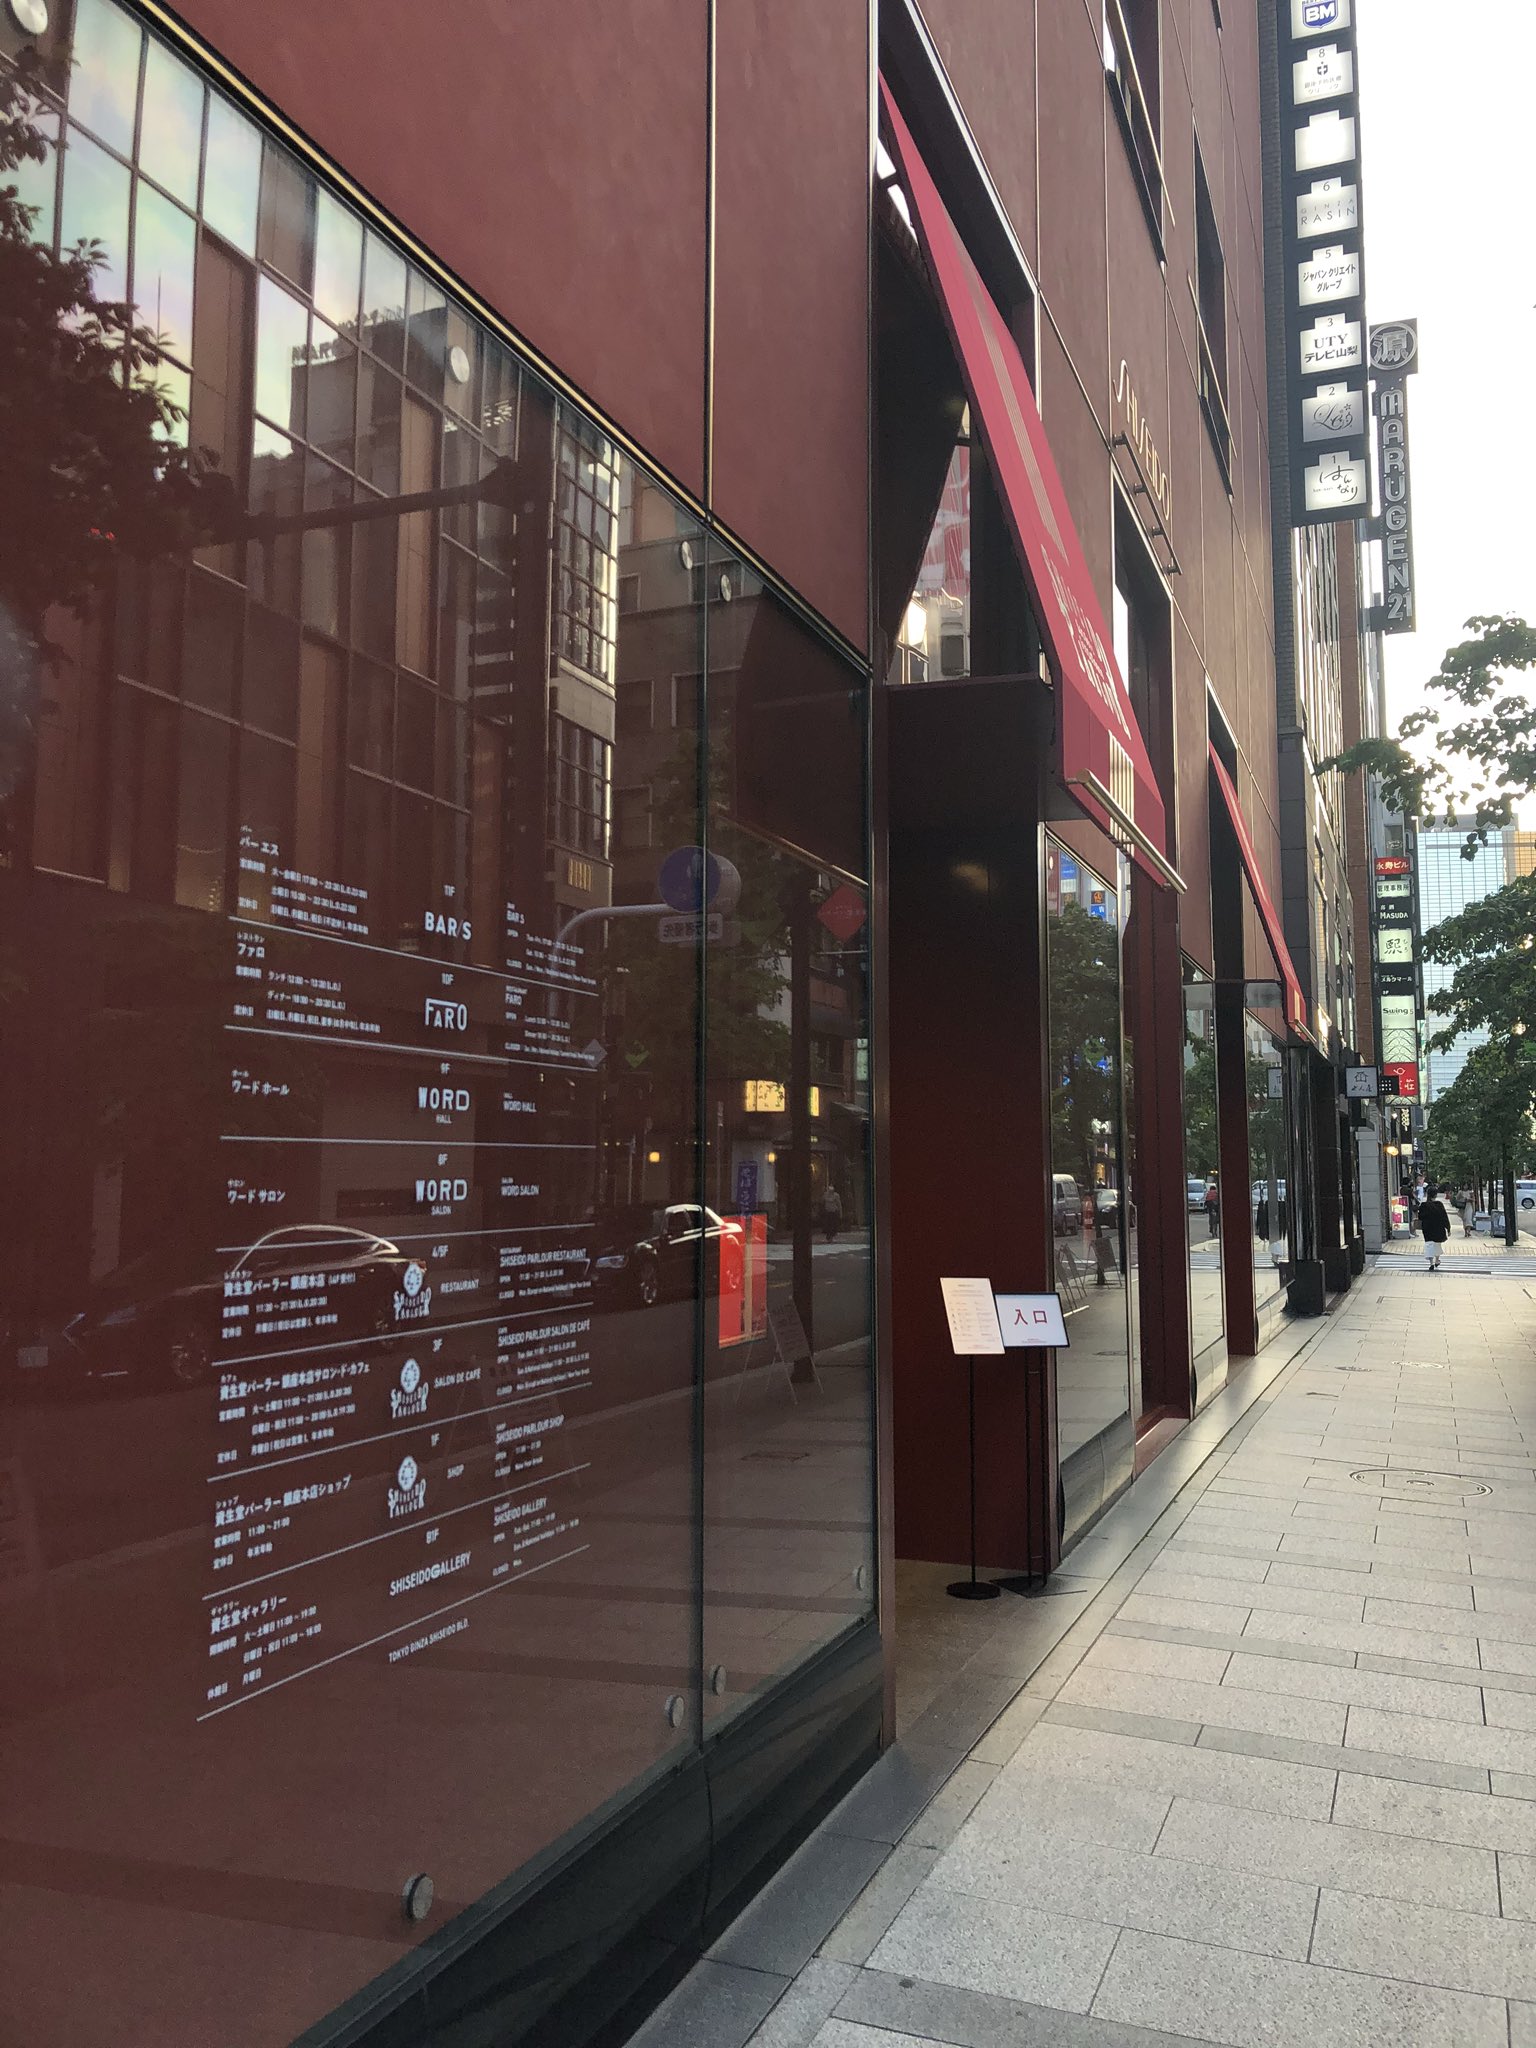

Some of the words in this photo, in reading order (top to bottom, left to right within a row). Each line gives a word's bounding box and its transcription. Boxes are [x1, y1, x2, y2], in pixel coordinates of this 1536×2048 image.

[1306, 3, 1335, 23] BM
[1319, 48, 1325, 58] 8
[1323, 182, 1330, 191] 6
[1301, 206, 1355, 225] RASIN
[1325, 249, 1331, 258] 5
[1317, 279, 1342, 292] グループ
[1327, 318, 1333, 327] 3
[1314, 333, 1347, 348] UTY
[1372, 330, 1409, 364] 源
[1304, 345, 1358, 363] テレビ山梨
[1328, 386, 1335, 396] 2
[1332, 455, 1336, 464] 1
[1381, 389, 1410, 589] MARUGEN
[1387, 592, 1412, 619] 21
[237, 943, 265, 958] ファロ
[425, 998, 467, 1031] FARO
[231, 1080, 260, 1094] ワード
[262, 1082, 290, 1095] ホール
[418, 1086, 470, 1111] WORD
[436, 1114, 452, 1124] HALL
[227, 1189, 256, 1204] ワード
[258, 1190, 286, 1203] サロン
[415, 1179, 467, 1202] WORD
[431, 1206, 451, 1216] SALON
[552, 1248, 587, 1261] RESTAURANT
[440, 1279, 479, 1293] RESTAURANT
[1014, 1309, 1048, 1325] 入口
[525, 1327, 550, 1341] PARLOUR
[550, 1325, 568, 1337] SALON
[569, 1323, 577, 1334] DE
[434, 1374, 455, 1388] SALON
[455, 1371, 464, 1383] DE
[447, 1464, 464, 1479] SHOP
[211, 1597, 287, 1635] 資生堂ギャラリー
[388, 1646, 410, 1663] TOKYO
[410, 1638, 429, 1655] GINZA
[429, 1625, 456, 1645] SHISEIDO
